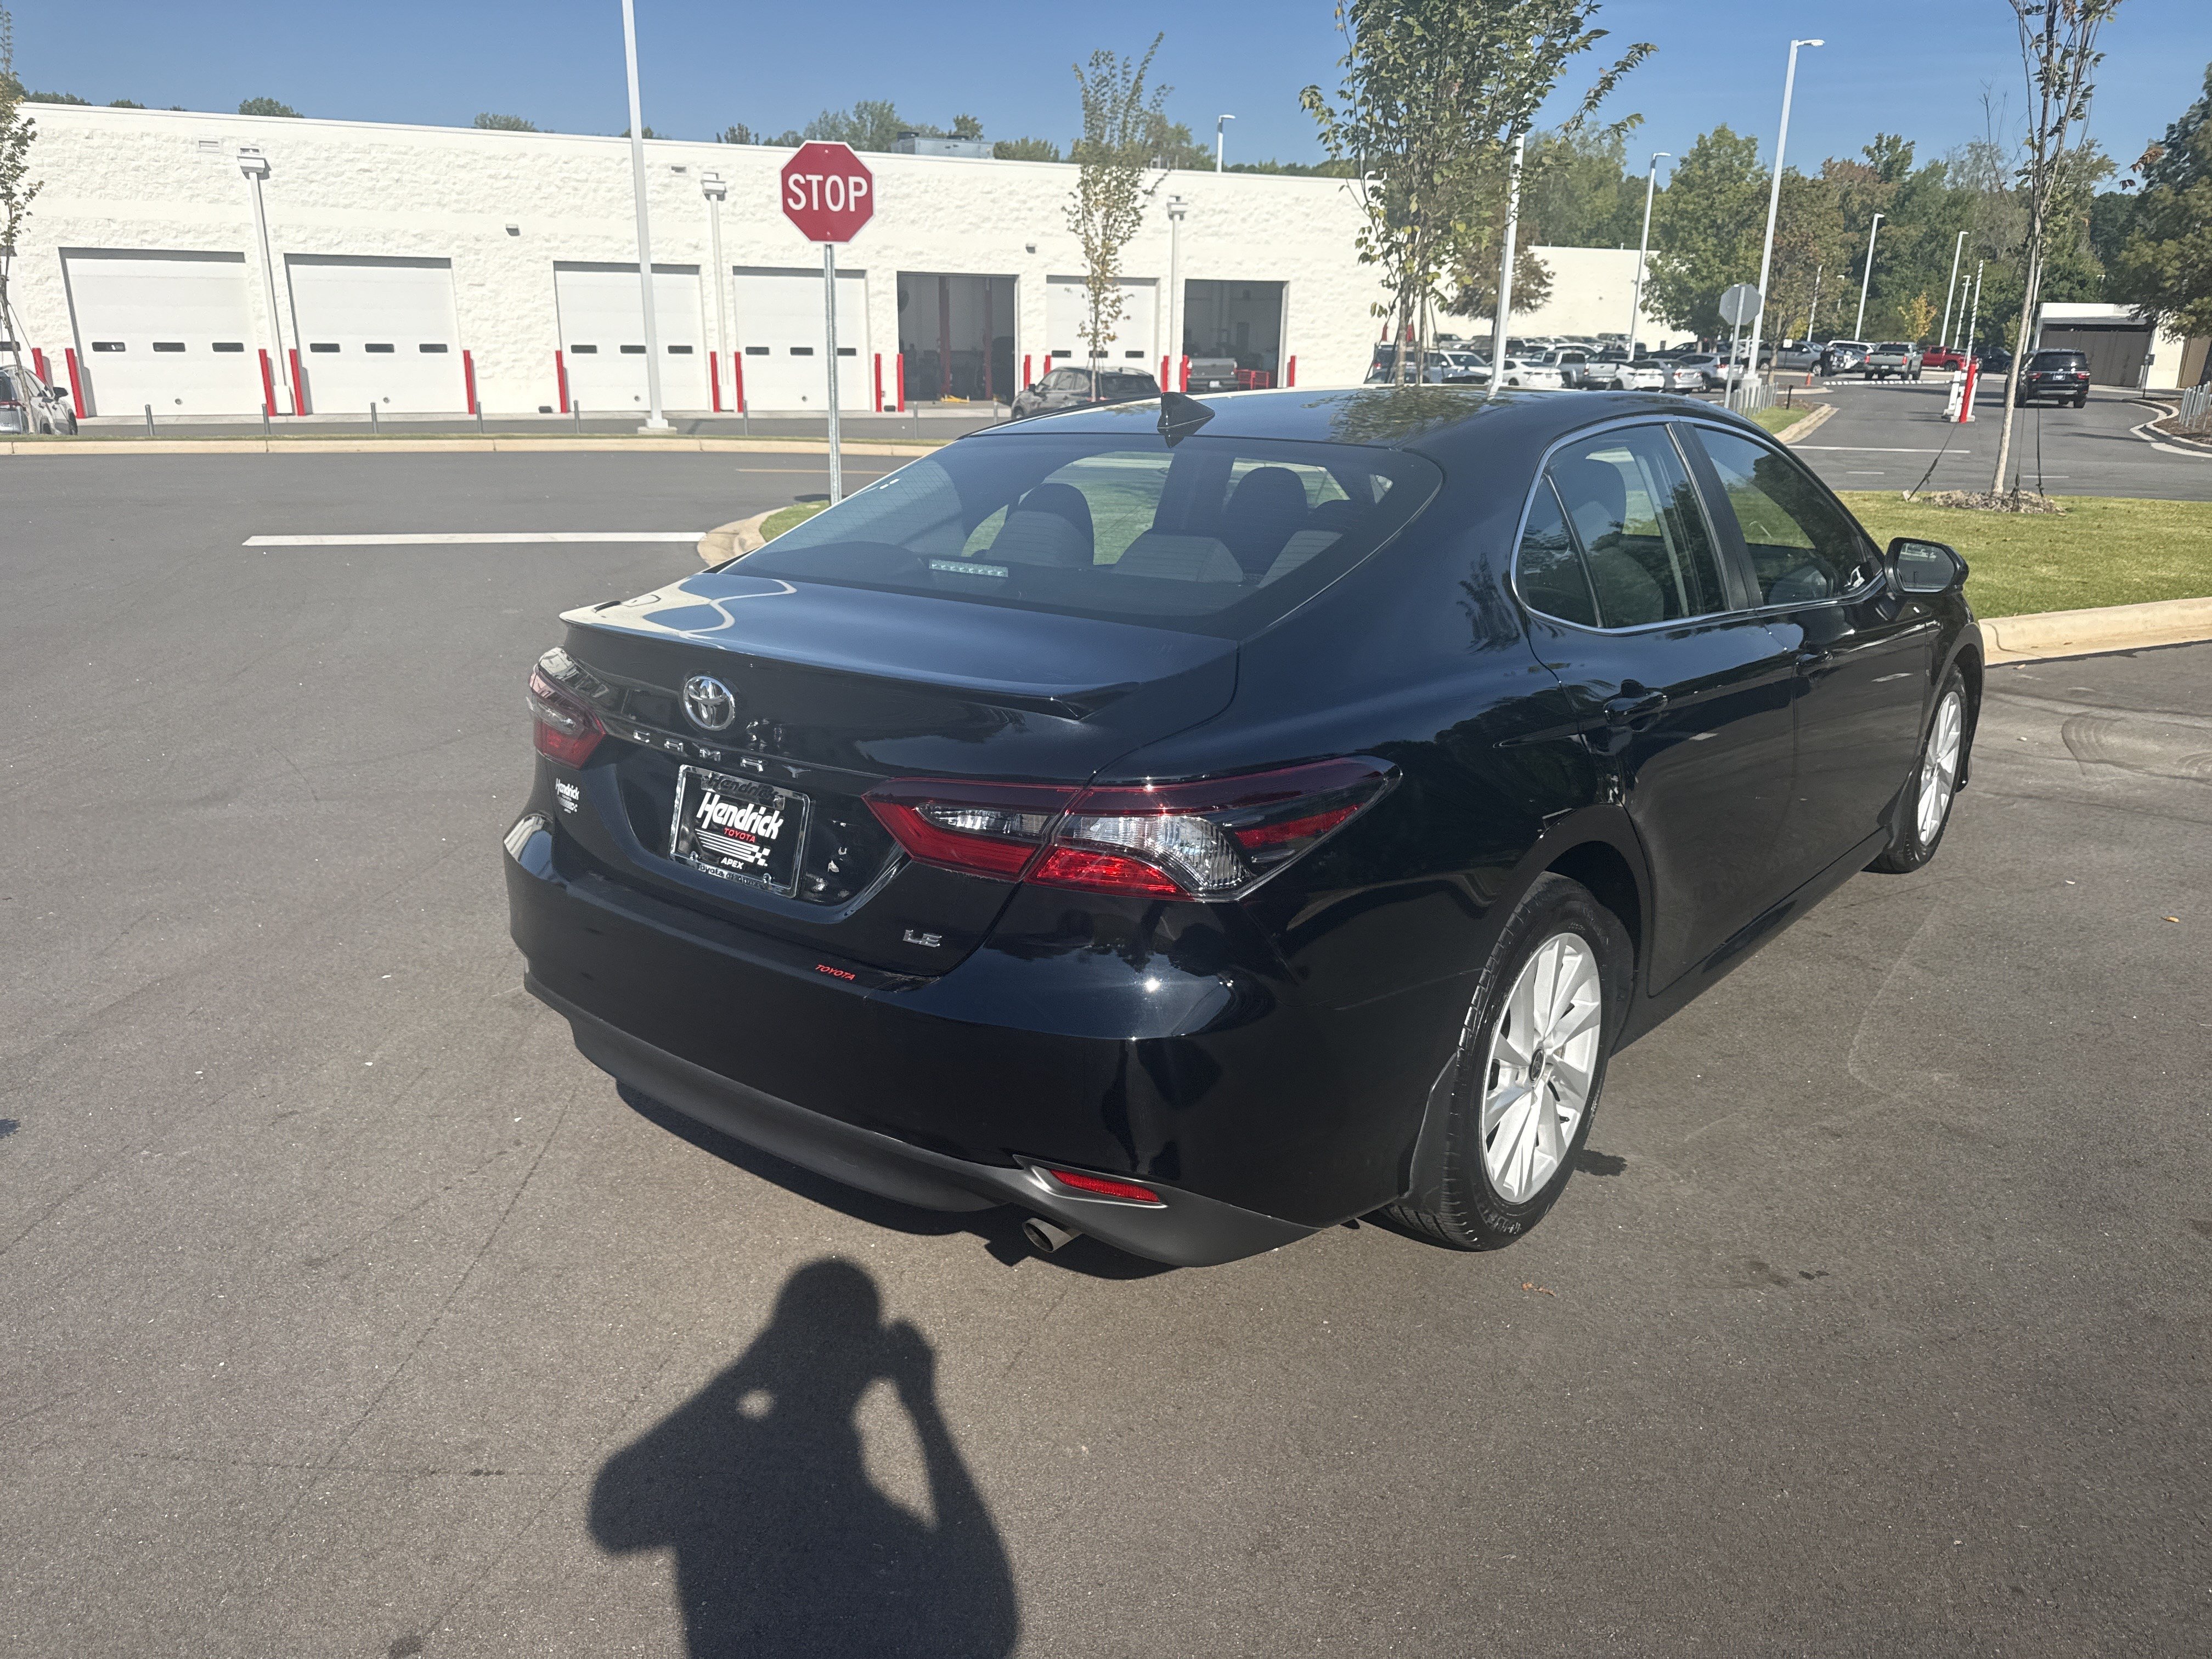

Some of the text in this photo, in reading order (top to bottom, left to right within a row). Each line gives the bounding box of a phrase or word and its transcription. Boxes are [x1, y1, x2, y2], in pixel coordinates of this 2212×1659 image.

[787, 173, 868, 212] STOP
[633, 729, 811, 779] CAMRY
[555, 777, 580, 800] Hendrick
[696, 791, 784, 839] Hendrick
[724, 827, 756, 843] TOYOTA
[698, 864, 725, 878] Toyota
[721, 857, 744, 870] APEX
[902, 929, 943, 948] LE
[815, 964, 856, 981] TOYOTA
